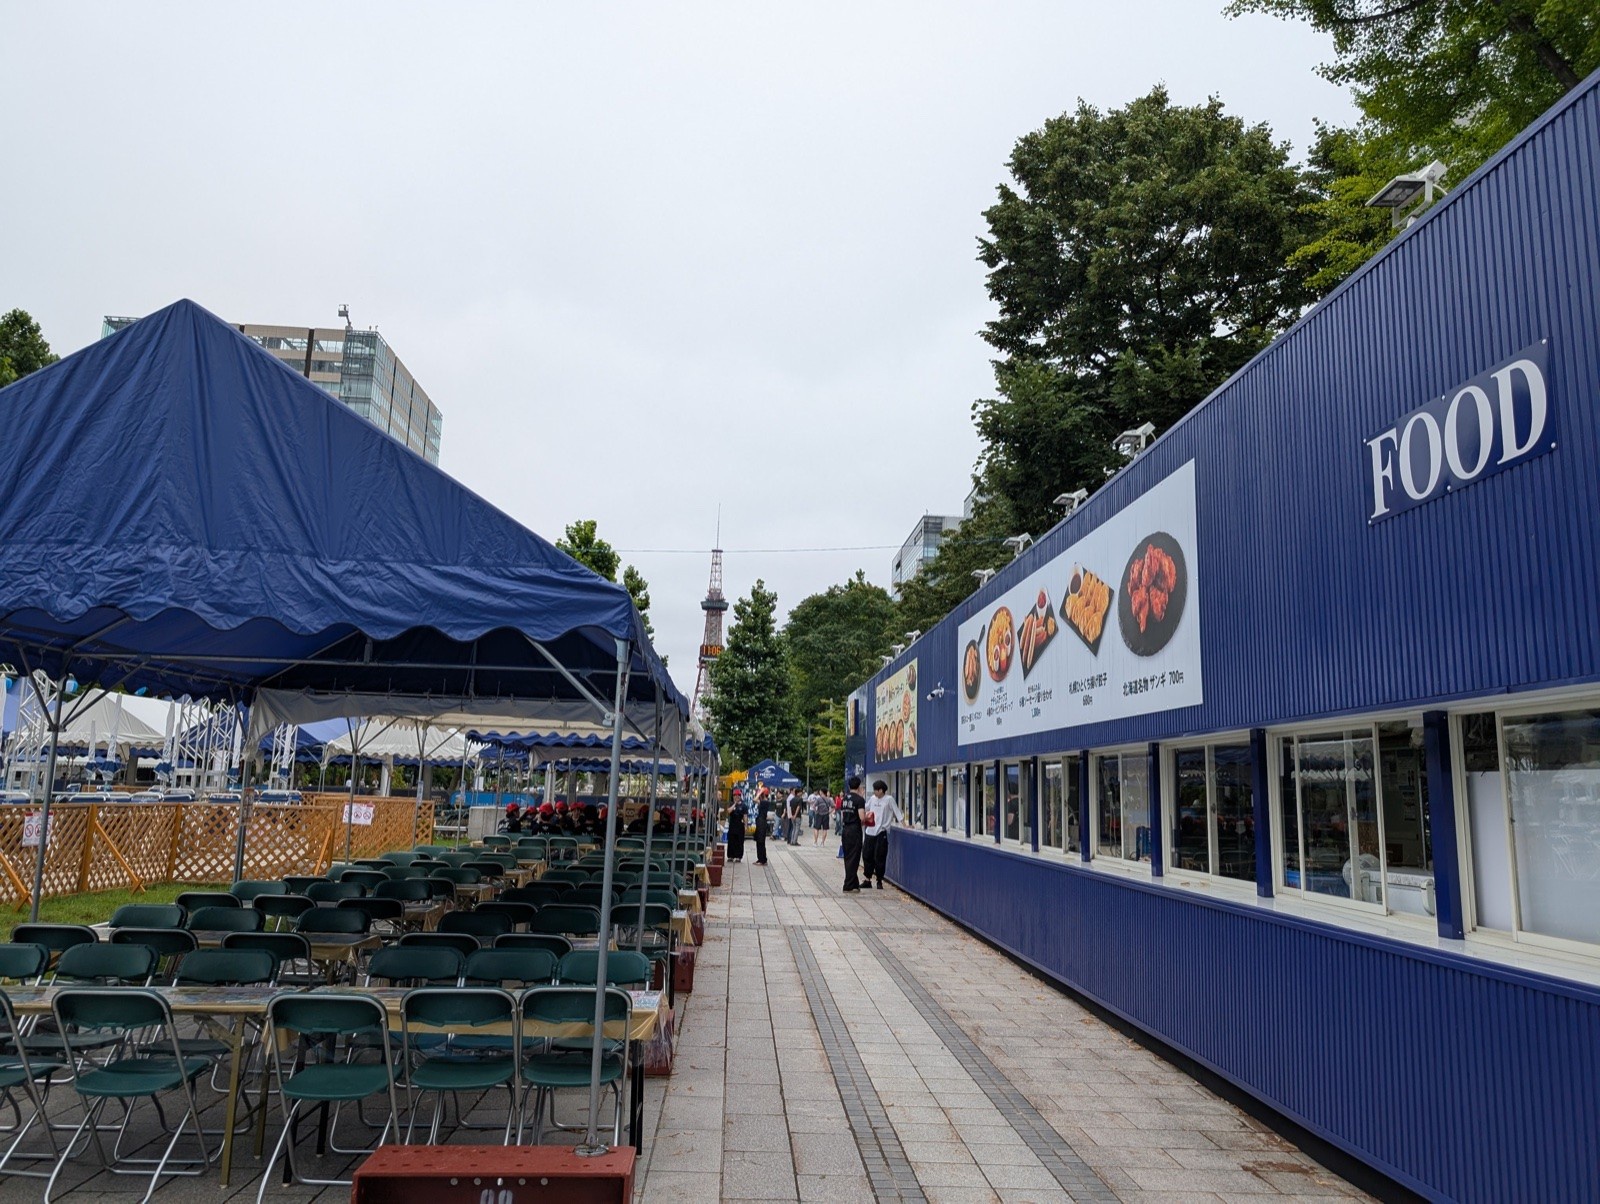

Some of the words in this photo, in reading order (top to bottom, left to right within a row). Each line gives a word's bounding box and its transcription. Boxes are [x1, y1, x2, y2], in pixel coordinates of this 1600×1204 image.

[1367, 359, 1547, 519] FOOD
[1122, 676, 1149, 697] 北海道名物
[1150, 672, 1167, 690] ザンギ
[1169, 670, 1185, 686] 700円
